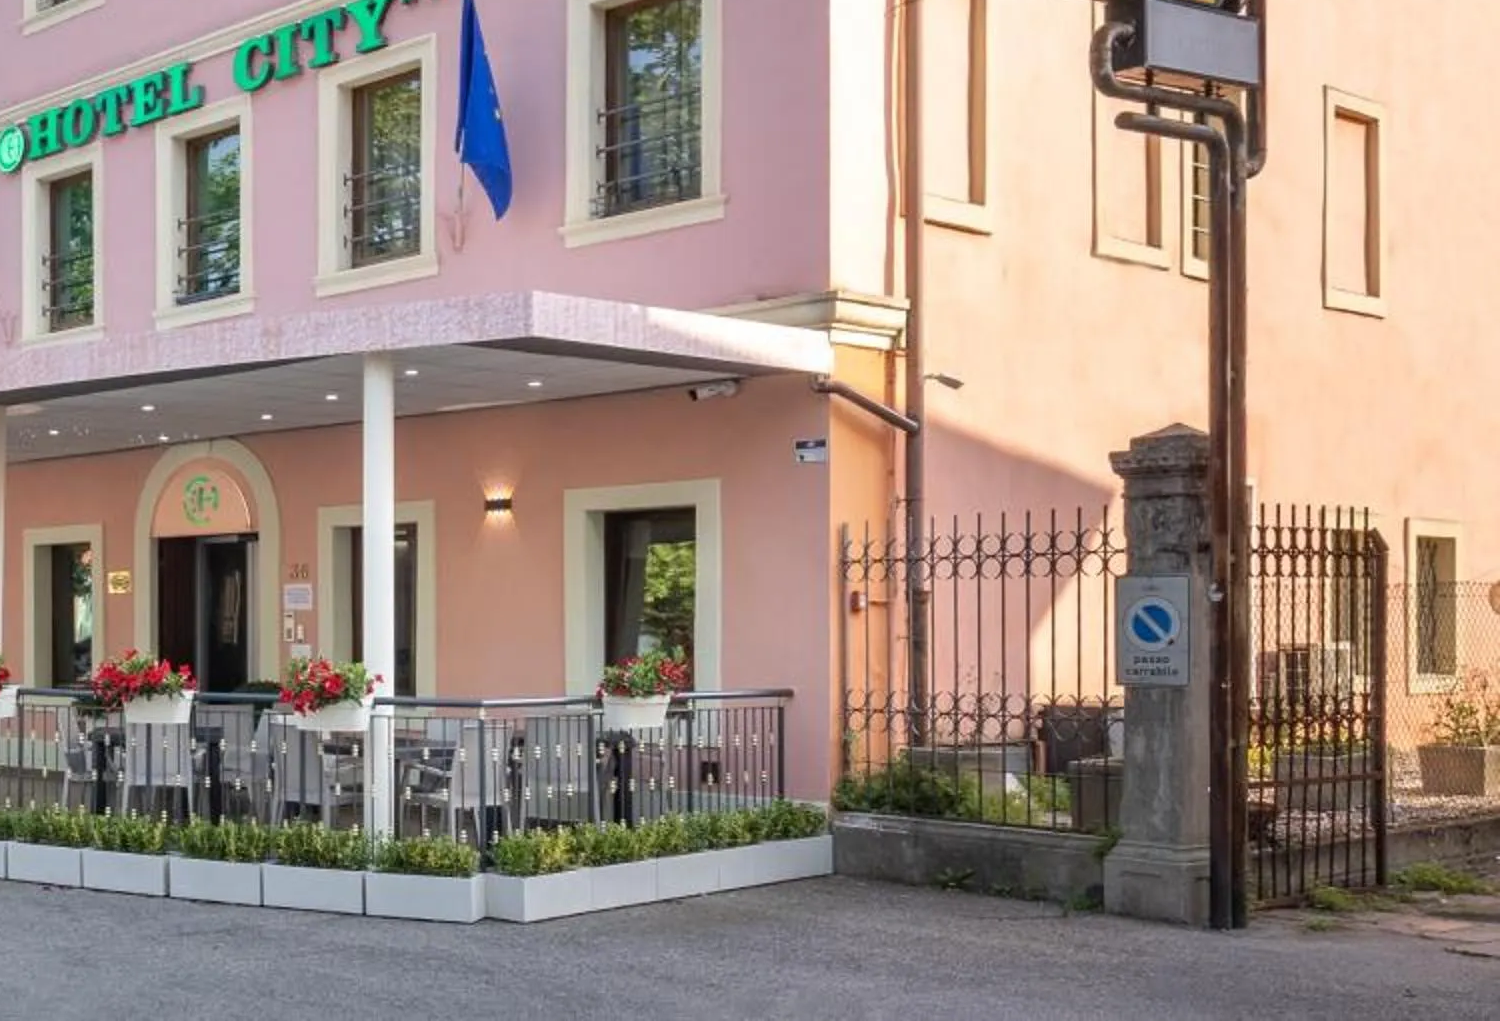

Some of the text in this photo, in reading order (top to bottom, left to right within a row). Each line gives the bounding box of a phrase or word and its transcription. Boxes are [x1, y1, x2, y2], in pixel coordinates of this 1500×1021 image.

[26, 63, 203, 161] HOTEL
[1133, 656, 1170, 665] passo
[1125, 666, 1179, 676] carrabile
